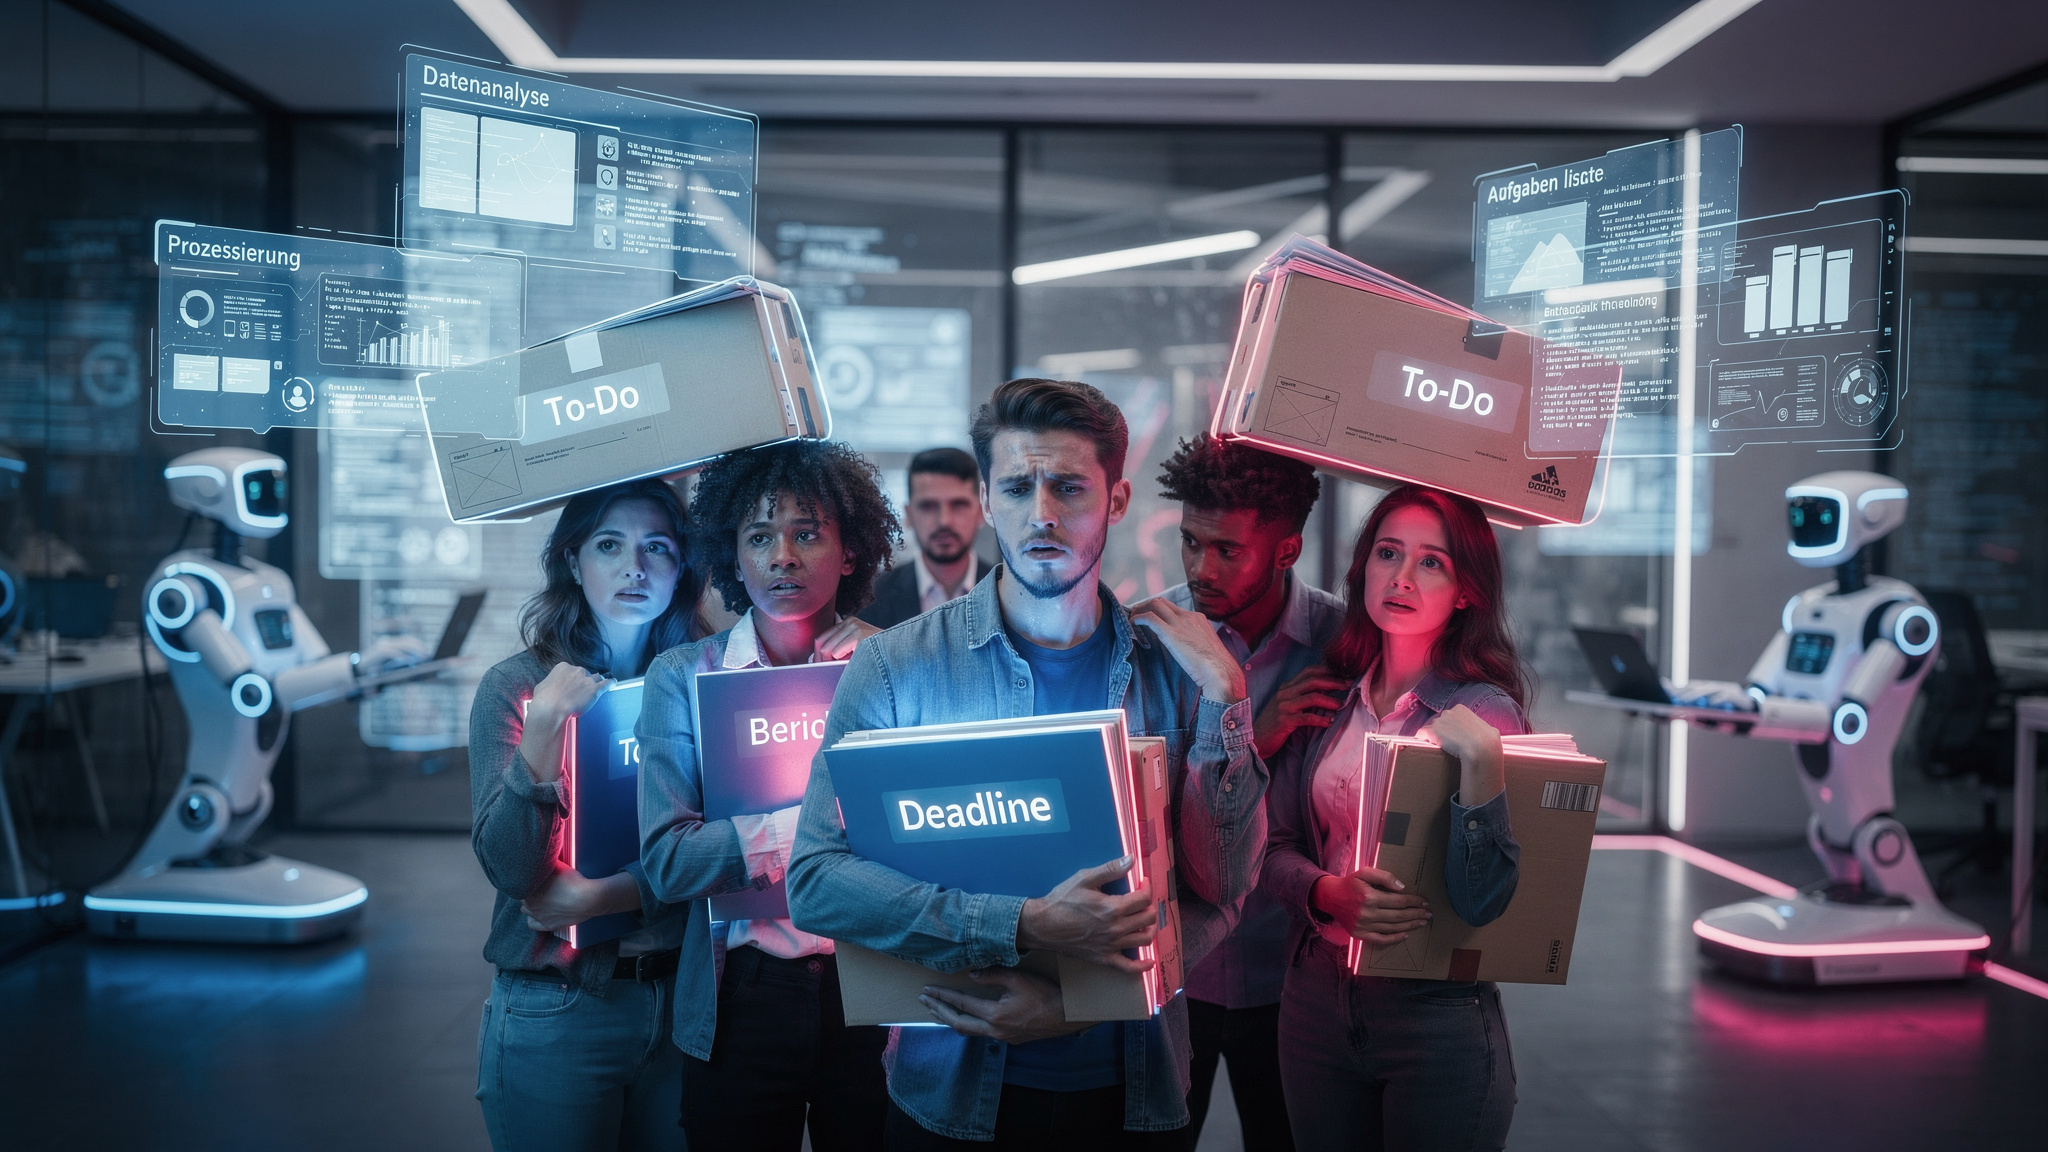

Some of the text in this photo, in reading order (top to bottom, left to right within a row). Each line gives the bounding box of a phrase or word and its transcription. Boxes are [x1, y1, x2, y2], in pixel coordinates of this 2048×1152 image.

[423, 64, 550, 108] Datenanalyse
[1487, 176, 1558, 204] Aufgaben
[168, 234, 301, 271] Prozessierung
[543, 385, 640, 426] To-Do
[1402, 365, 1494, 416] To-Do
[898, 791, 1052, 831] Deadline
